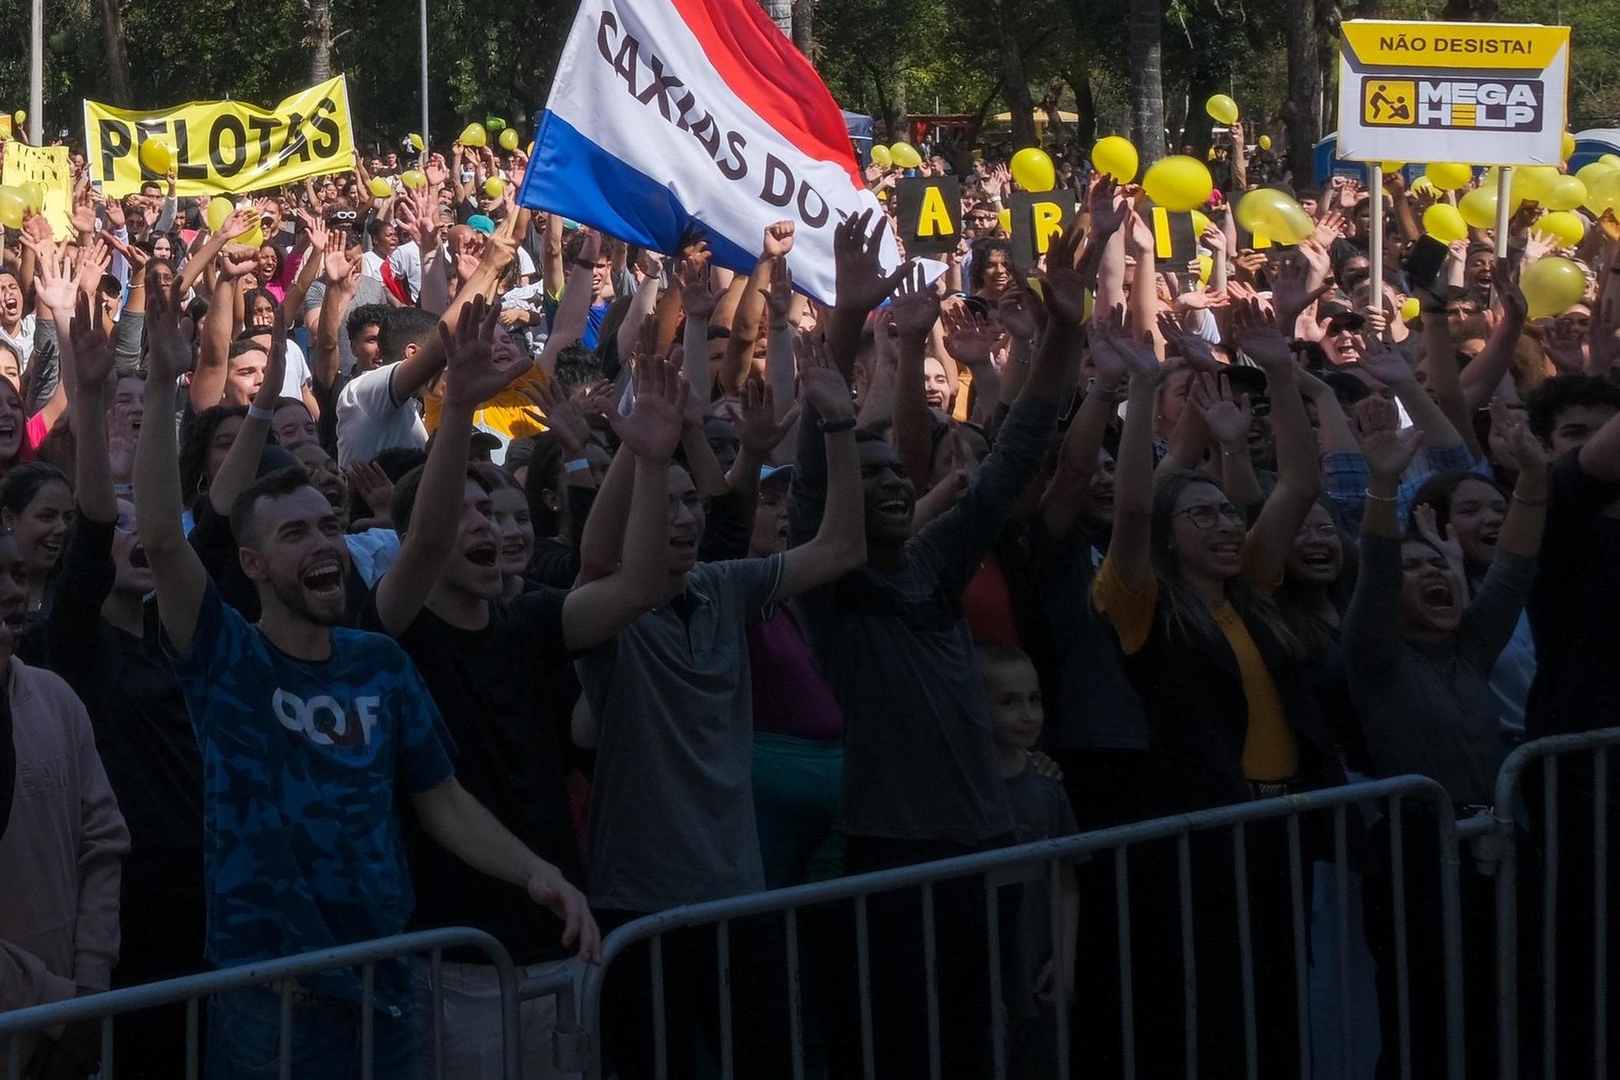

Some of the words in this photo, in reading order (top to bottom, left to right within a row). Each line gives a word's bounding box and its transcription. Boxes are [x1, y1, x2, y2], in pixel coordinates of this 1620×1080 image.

[1379, 33, 1427, 52] NÃO
[1433, 37, 1533, 55] DESISTA!
[597, 10, 748, 180] CAXIAS
[1418, 81, 1537, 107] MEGA
[1418, 102, 1535, 128] HELP
[98, 97, 340, 182] PELOTAS
[759, 152, 830, 228] DO
